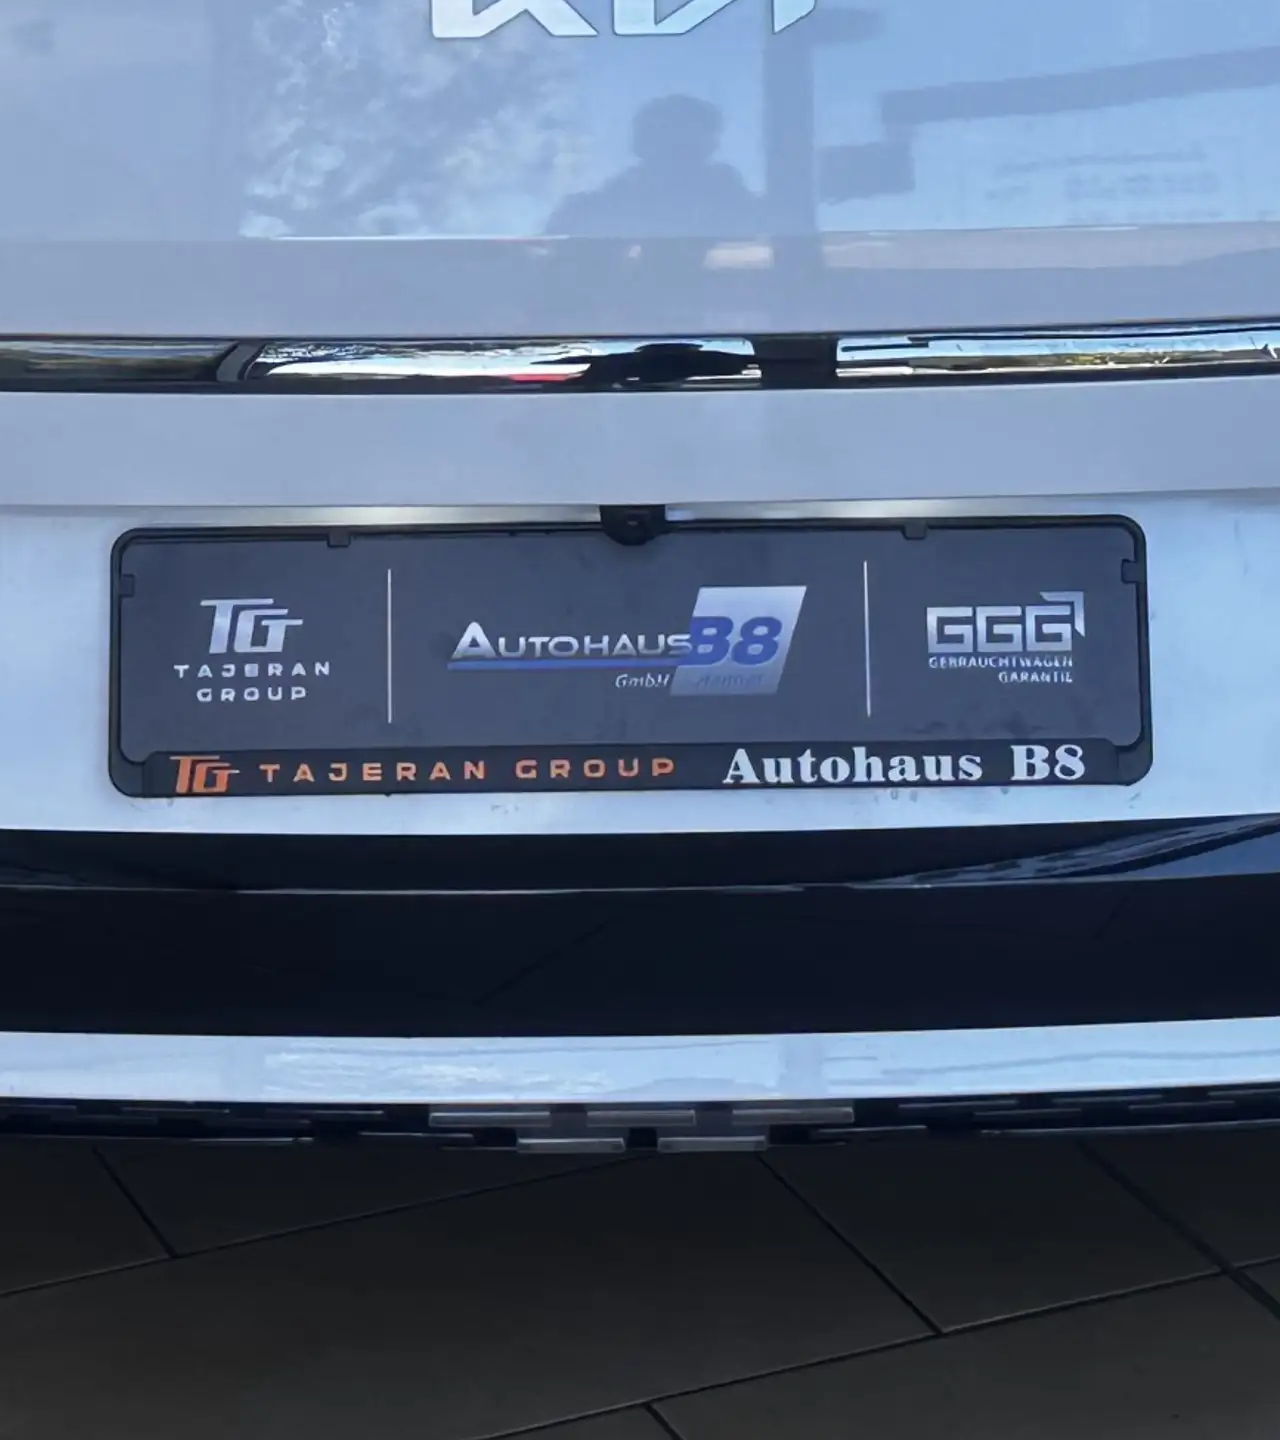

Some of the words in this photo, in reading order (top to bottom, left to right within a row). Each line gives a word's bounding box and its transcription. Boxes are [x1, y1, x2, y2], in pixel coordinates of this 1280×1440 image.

[686, 616, 783, 666] B8
[926, 605, 1072, 653] GGG
[173, 662, 330, 679] TAJERAN
[615, 673, 670, 689] GmbH
[196, 686, 307, 702] GROUP
[260, 761, 486, 783] TAJERAN
[515, 758, 675, 779] GROUP
[722, 746, 984, 784] Autohaus
[1010, 744, 1086, 782] B8
